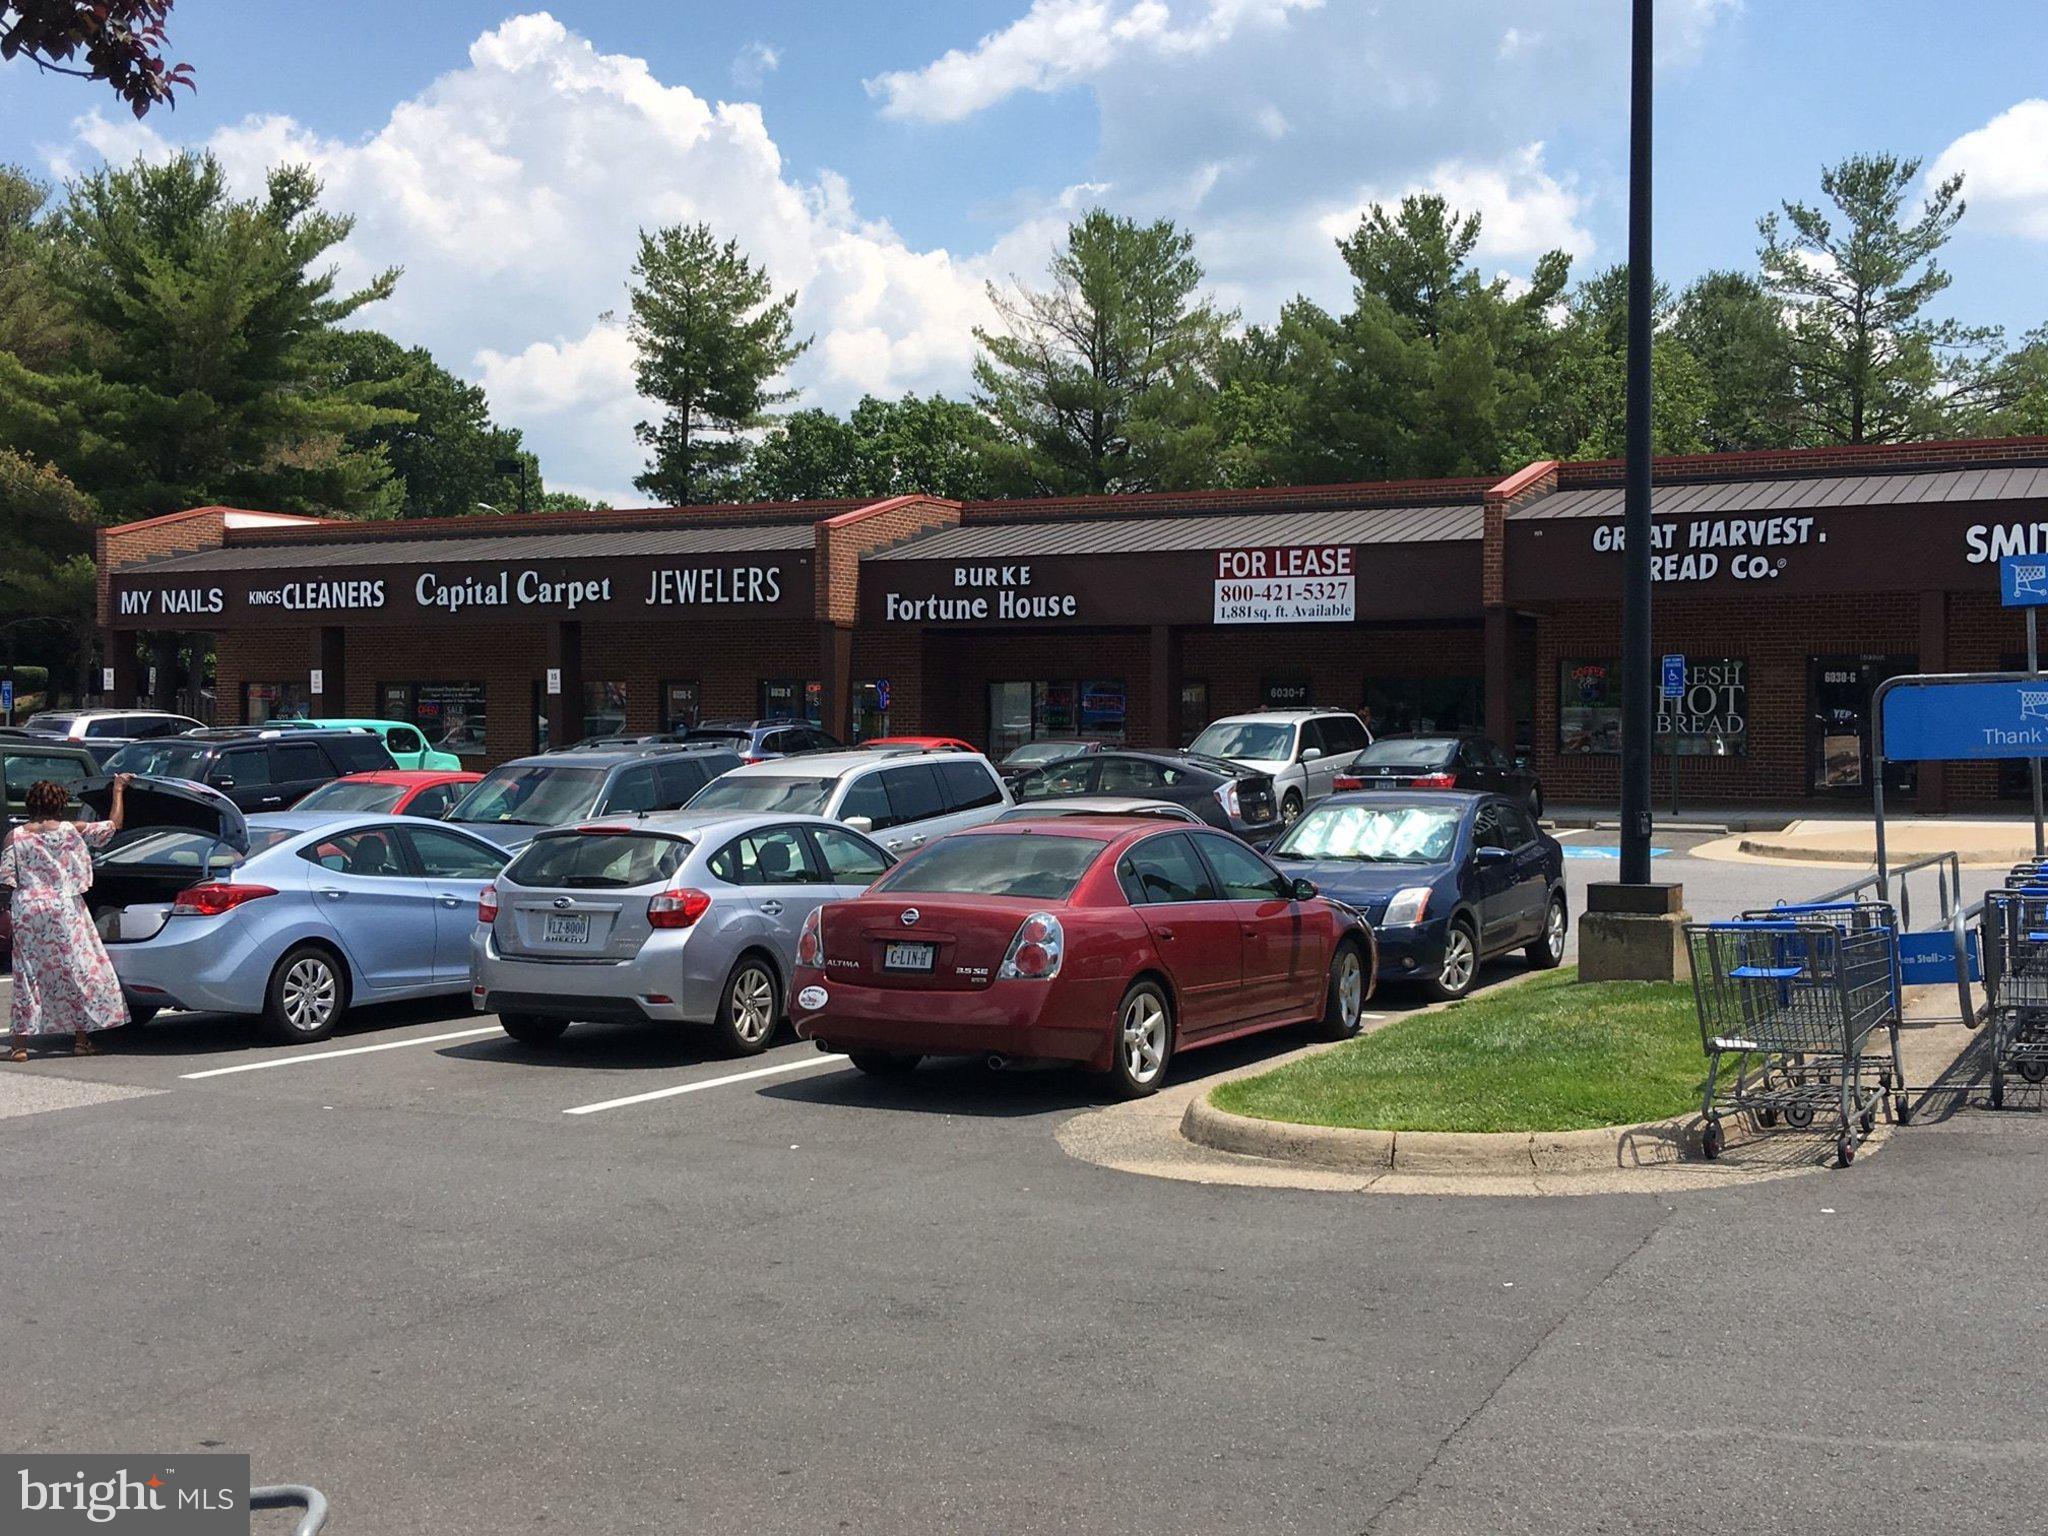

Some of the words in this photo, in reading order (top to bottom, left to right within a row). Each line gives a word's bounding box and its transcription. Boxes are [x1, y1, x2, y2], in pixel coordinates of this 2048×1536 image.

[1593, 524, 1677, 551] GRAT
[1689, 517, 1813, 549] HARVEST
[954, 566, 1031, 586] BURKE
[1219, 551, 1266, 578] FOR
[1276, 548, 1350, 576] LEASE
[1650, 553, 1718, 582] READ
[249, 590, 281, 605] KING'S
[282, 580, 385, 609] CLEANERS
[415, 571, 508, 612] Capital
[516, 570, 611, 609] Carpet
[645, 567, 780, 605] JEWELERS
[1221, 582, 1348, 602] 800-421-5327
[121, 591, 152, 614] MY
[161, 588, 223, 613] NAILS
[886, 593, 988, 621] Fortune
[999, 590, 1076, 619] House
[1275, 605, 1288, 618] ft.
[1292, 603, 1351, 618] Available
[1683, 666, 1741, 685] RESH
[1656, 684, 1745, 715] HOT
[1656, 715, 1744, 734] BREAD
[1982, 727, 2042, 745] Thank
[826, 959, 860, 968] ALTIMA
